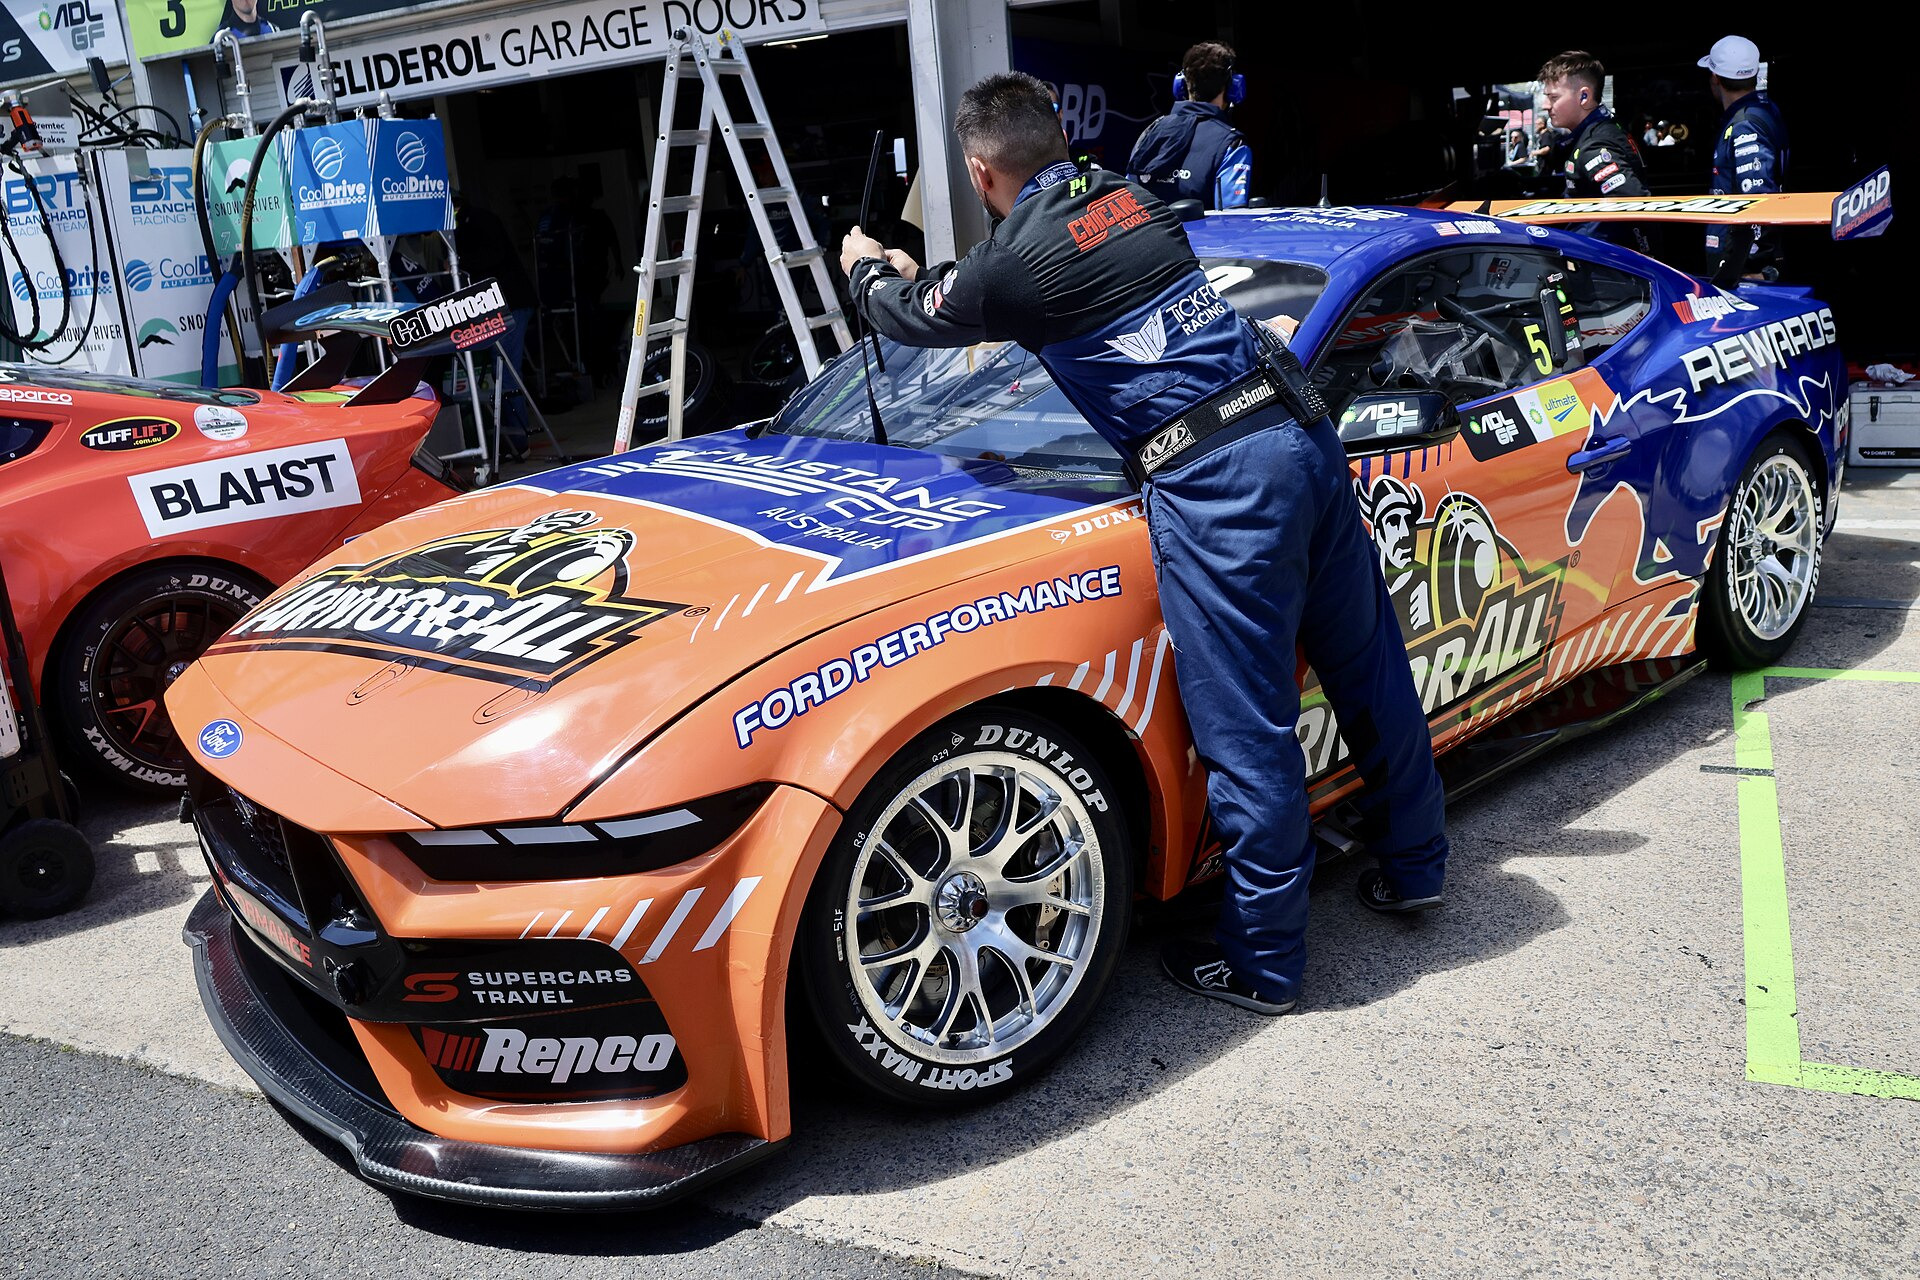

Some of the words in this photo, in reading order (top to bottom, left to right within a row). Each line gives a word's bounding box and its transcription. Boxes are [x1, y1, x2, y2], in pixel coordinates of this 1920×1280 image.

[54, 0, 103, 30] ADL
[71, 22, 105, 51] GF
[500, 10, 652, 66] GARAGE
[664, 0, 806, 41] DOORS
[1052, 82, 1107, 139] RD
[5, 172, 79, 215] BRT
[130, 167, 195, 202] BR
[299, 179, 366, 203] CoolDrive
[382, 174, 444, 194] CoolDrive
[1752, 178, 1764, 187] bp
[131, 202, 197, 215] BLANCH
[1836, 170, 1890, 228] FORD
[56, 221, 88, 233] TEAM
[133, 214, 187, 226] RACING
[303, 221, 316, 242] 3
[1067, 192, 1144, 244] CHICANE
[1118, 209, 1151, 231] TOOLS
[1836, 197, 1889, 240] PERFORMANCE
[160, 255, 213, 279] CoolD
[163, 278, 192, 288] AUTO
[389, 281, 506, 347] CalOffroad
[1166, 283, 1221, 323] TICKFO
[93, 324, 122, 340] RIVER
[179, 313, 207, 332] SNO
[450, 312, 505, 344] Gabriel
[1181, 302, 1225, 336] RACING
[1523, 323, 1553, 375] 5
[1679, 308, 1836, 393] REWARDS
[1218, 378, 1276, 421] mechani
[1356, 401, 1419, 423] ADL
[1545, 393, 1577, 411] ultimate
[85, 423, 170, 447] TUFFLIFT
[1375, 416, 1418, 436] GF
[1481, 410, 1515, 434] ADL
[1496, 426, 1519, 446] GF
[133, 436, 162, 447] .com.au
[150, 453, 336, 521] BLAHST
[722, 452, 1005, 517] MUSTANG
[756, 506, 894, 551] AUSTRALIA
[825, 496, 945, 532] CUP
[1072, 505, 1147, 537] DUNL
[187, 574, 262, 608] DUNL
[83, 726, 134, 771] MAXX
[203, 723, 235, 753] Ford
[129, 766, 187, 787] PORT
[974, 724, 1109, 813] DUNLOP
[853, 831, 866, 848] R8
[833, 908, 843, 932] 5LF
[469, 968, 632, 986] SUPERCARS
[472, 990, 573, 1004] TRAVEL
[847, 1015, 924, 1082] MAXX
[919, 1057, 1013, 1091] SPORT
